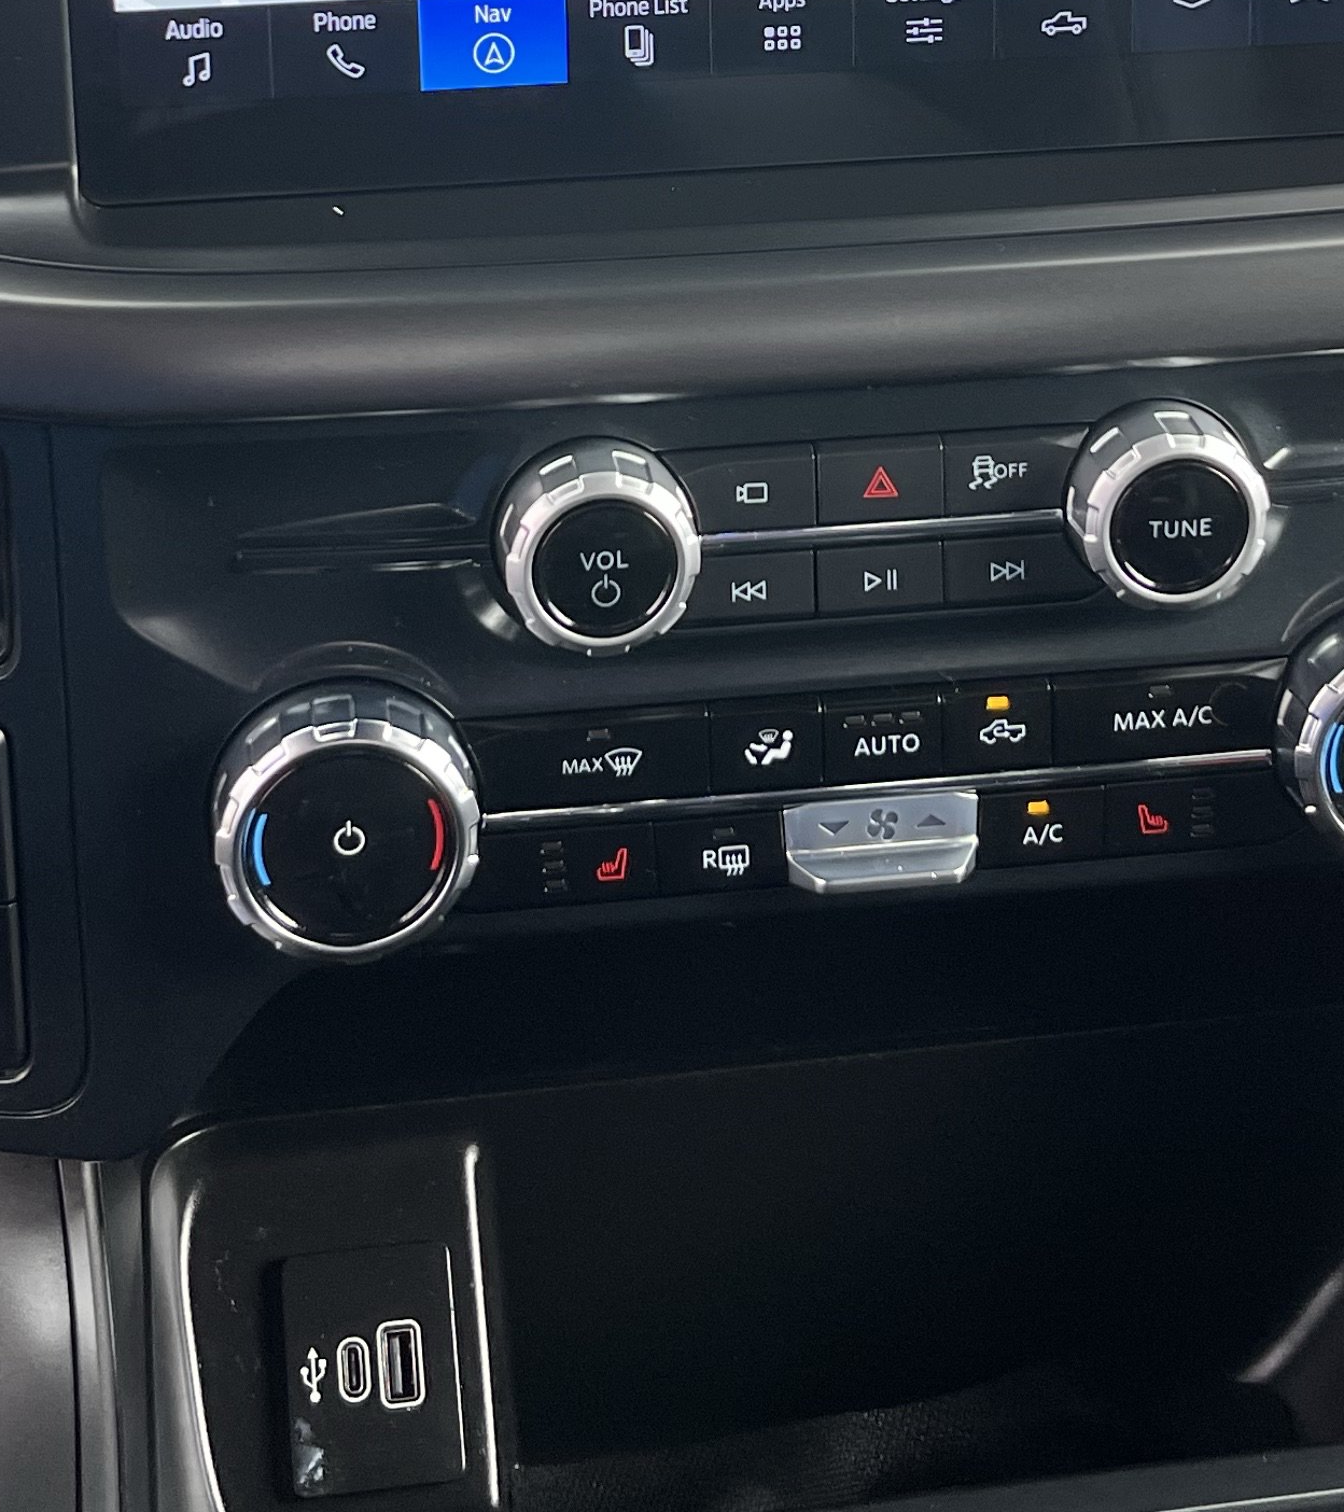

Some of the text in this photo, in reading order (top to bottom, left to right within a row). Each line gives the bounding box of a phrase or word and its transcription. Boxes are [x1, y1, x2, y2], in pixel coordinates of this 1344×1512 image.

[313, 11, 376, 33] Phone
[475, 4, 512, 25] Nav
[165, 18, 223, 41] Audio
[995, 461, 1029, 480] OFF
[1148, 516, 1213, 541] TUNE
[579, 549, 629, 573] VOL
[1113, 705, 1213, 732] MAX A/C
[854, 733, 921, 757] AUTO
[562, 756, 604, 776] MAX
[1022, 823, 1064, 846] A/C
[703, 850, 717, 870] R
